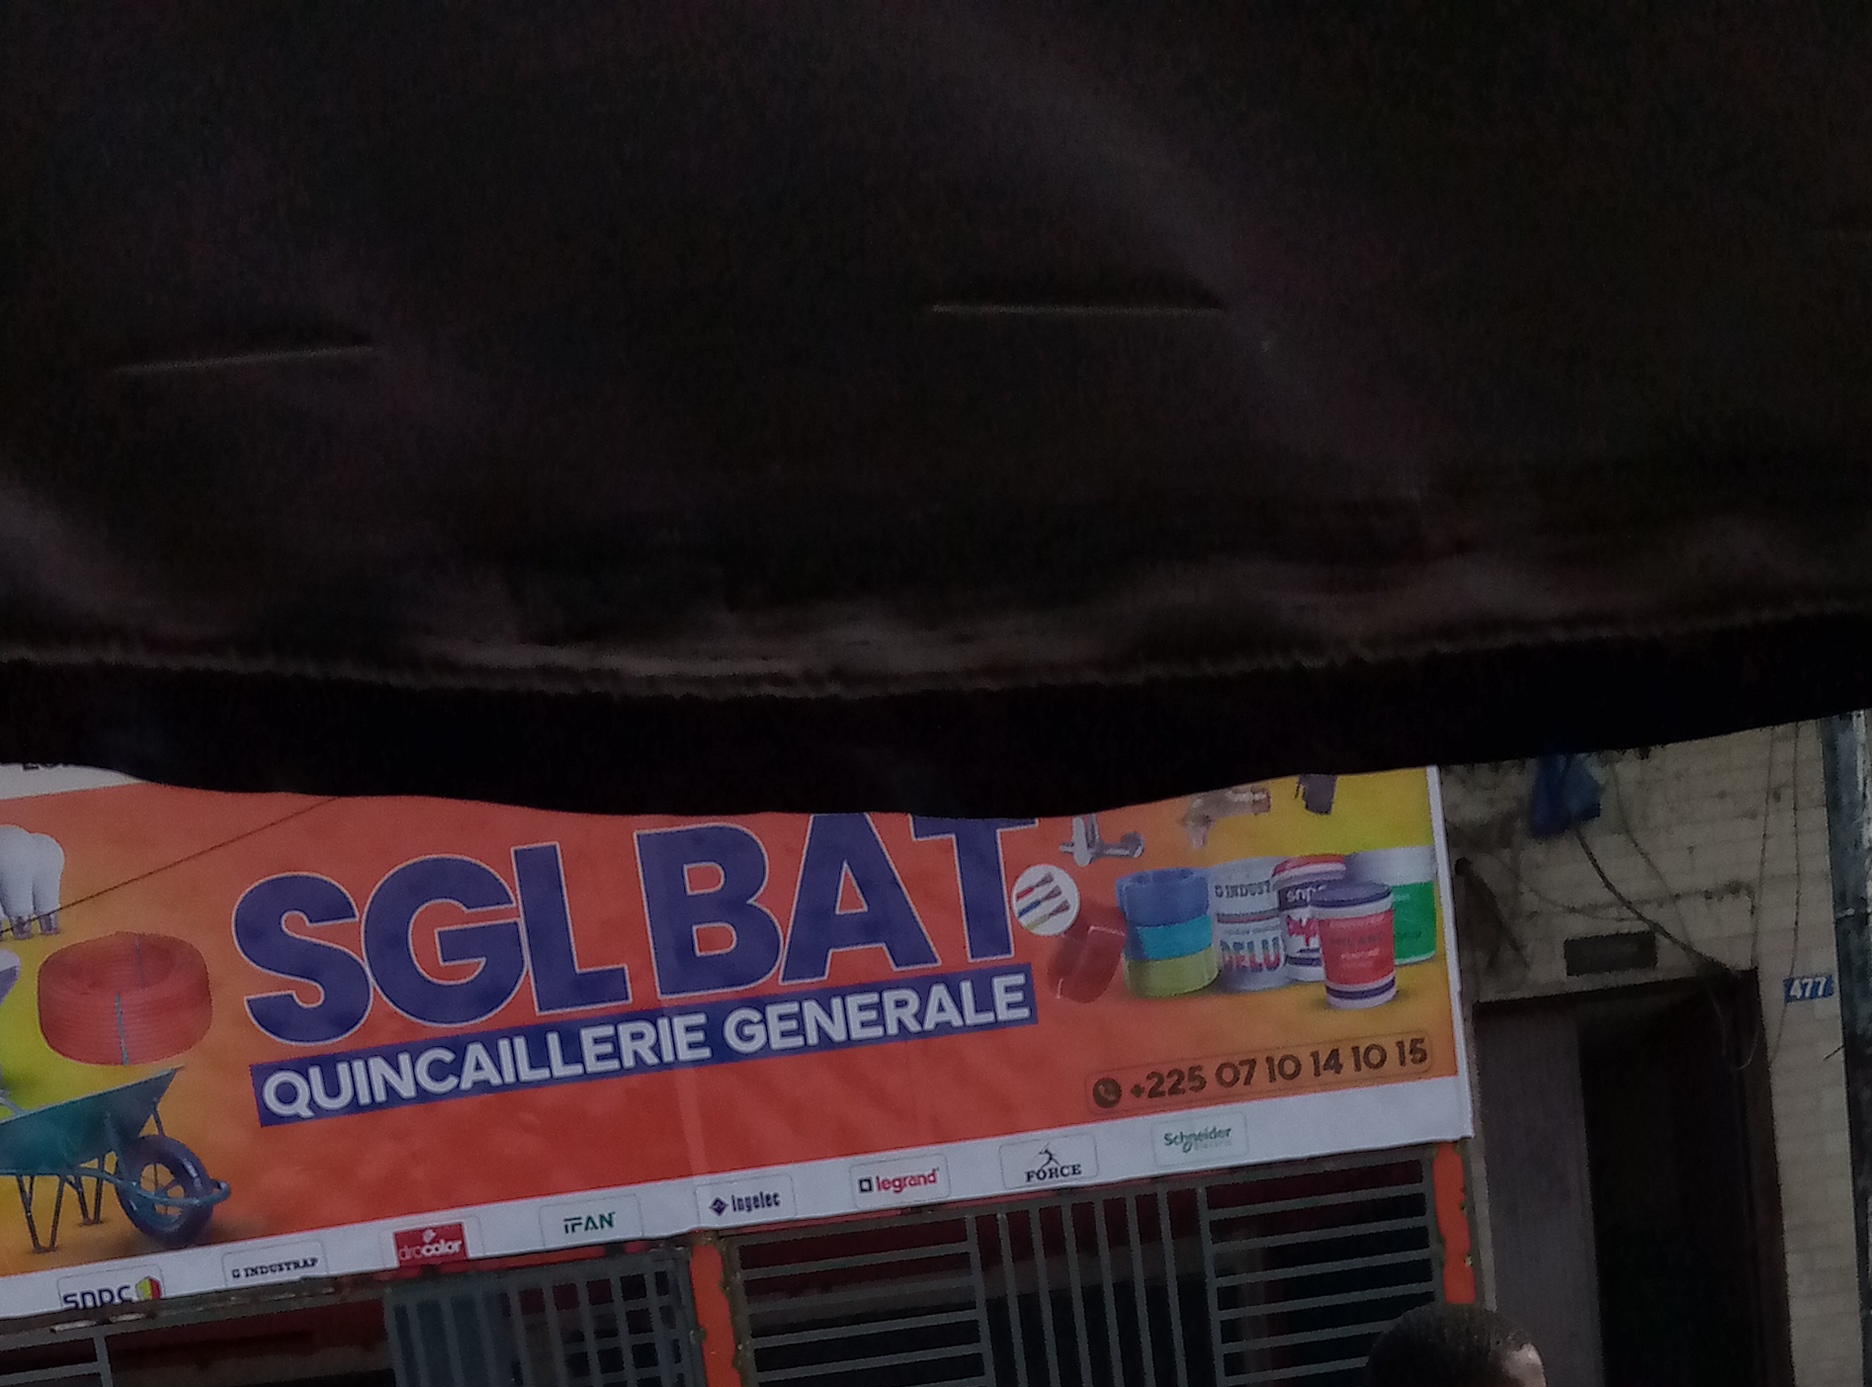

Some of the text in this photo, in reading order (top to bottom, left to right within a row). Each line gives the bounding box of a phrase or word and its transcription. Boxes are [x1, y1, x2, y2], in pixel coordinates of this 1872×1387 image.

[232, 813, 1038, 1047] SGL BAT
[1790, 977, 1827, 999] 477
[261, 972, 1031, 1118] QUINCAILLERIE GENERALE
[1130, 1037, 1429, 1100] +225 07 10 14 10 15
[1163, 1126, 1232, 1153] Schneider
[876, 1168, 937, 1193] legrand
[1023, 1163, 1082, 1183] FORCE
